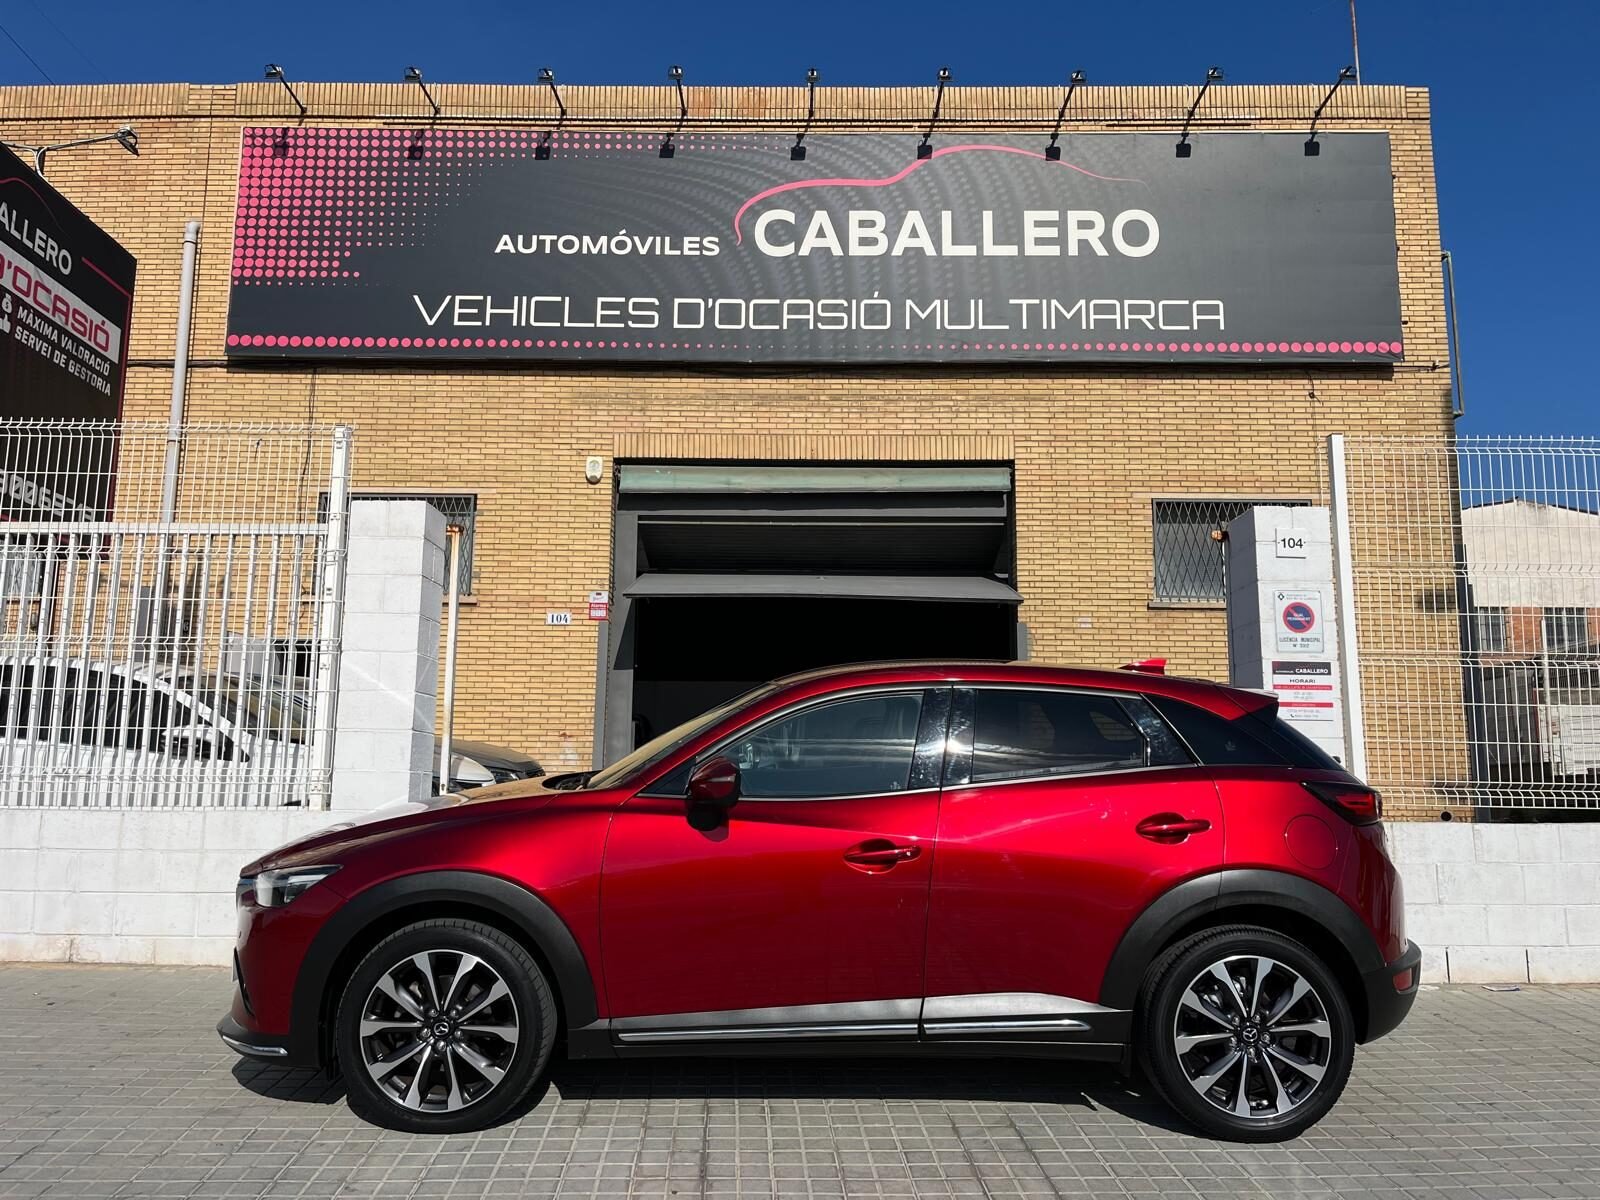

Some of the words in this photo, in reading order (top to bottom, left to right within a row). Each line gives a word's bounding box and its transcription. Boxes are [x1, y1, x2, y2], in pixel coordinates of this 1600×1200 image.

[494, 229, 721, 257] AUTOMÓVILES
[754, 208, 1161, 259] CABALLERO
[412, 294, 660, 329] VEHICLES
[672, 291, 889, 331] D'OCASIÓ
[905, 298, 1226, 331] MULTIMARCA
[14, 327, 51, 359] SERVEI
[53, 349, 66, 368] DE
[68, 359, 111, 397] GESTORIA
[17, 305, 59, 346] MÀXIMA
[61, 334, 111, 377] VALORACIÓ
[1280, 537, 1304, 549] 104
[551, 614, 568, 623] 104
